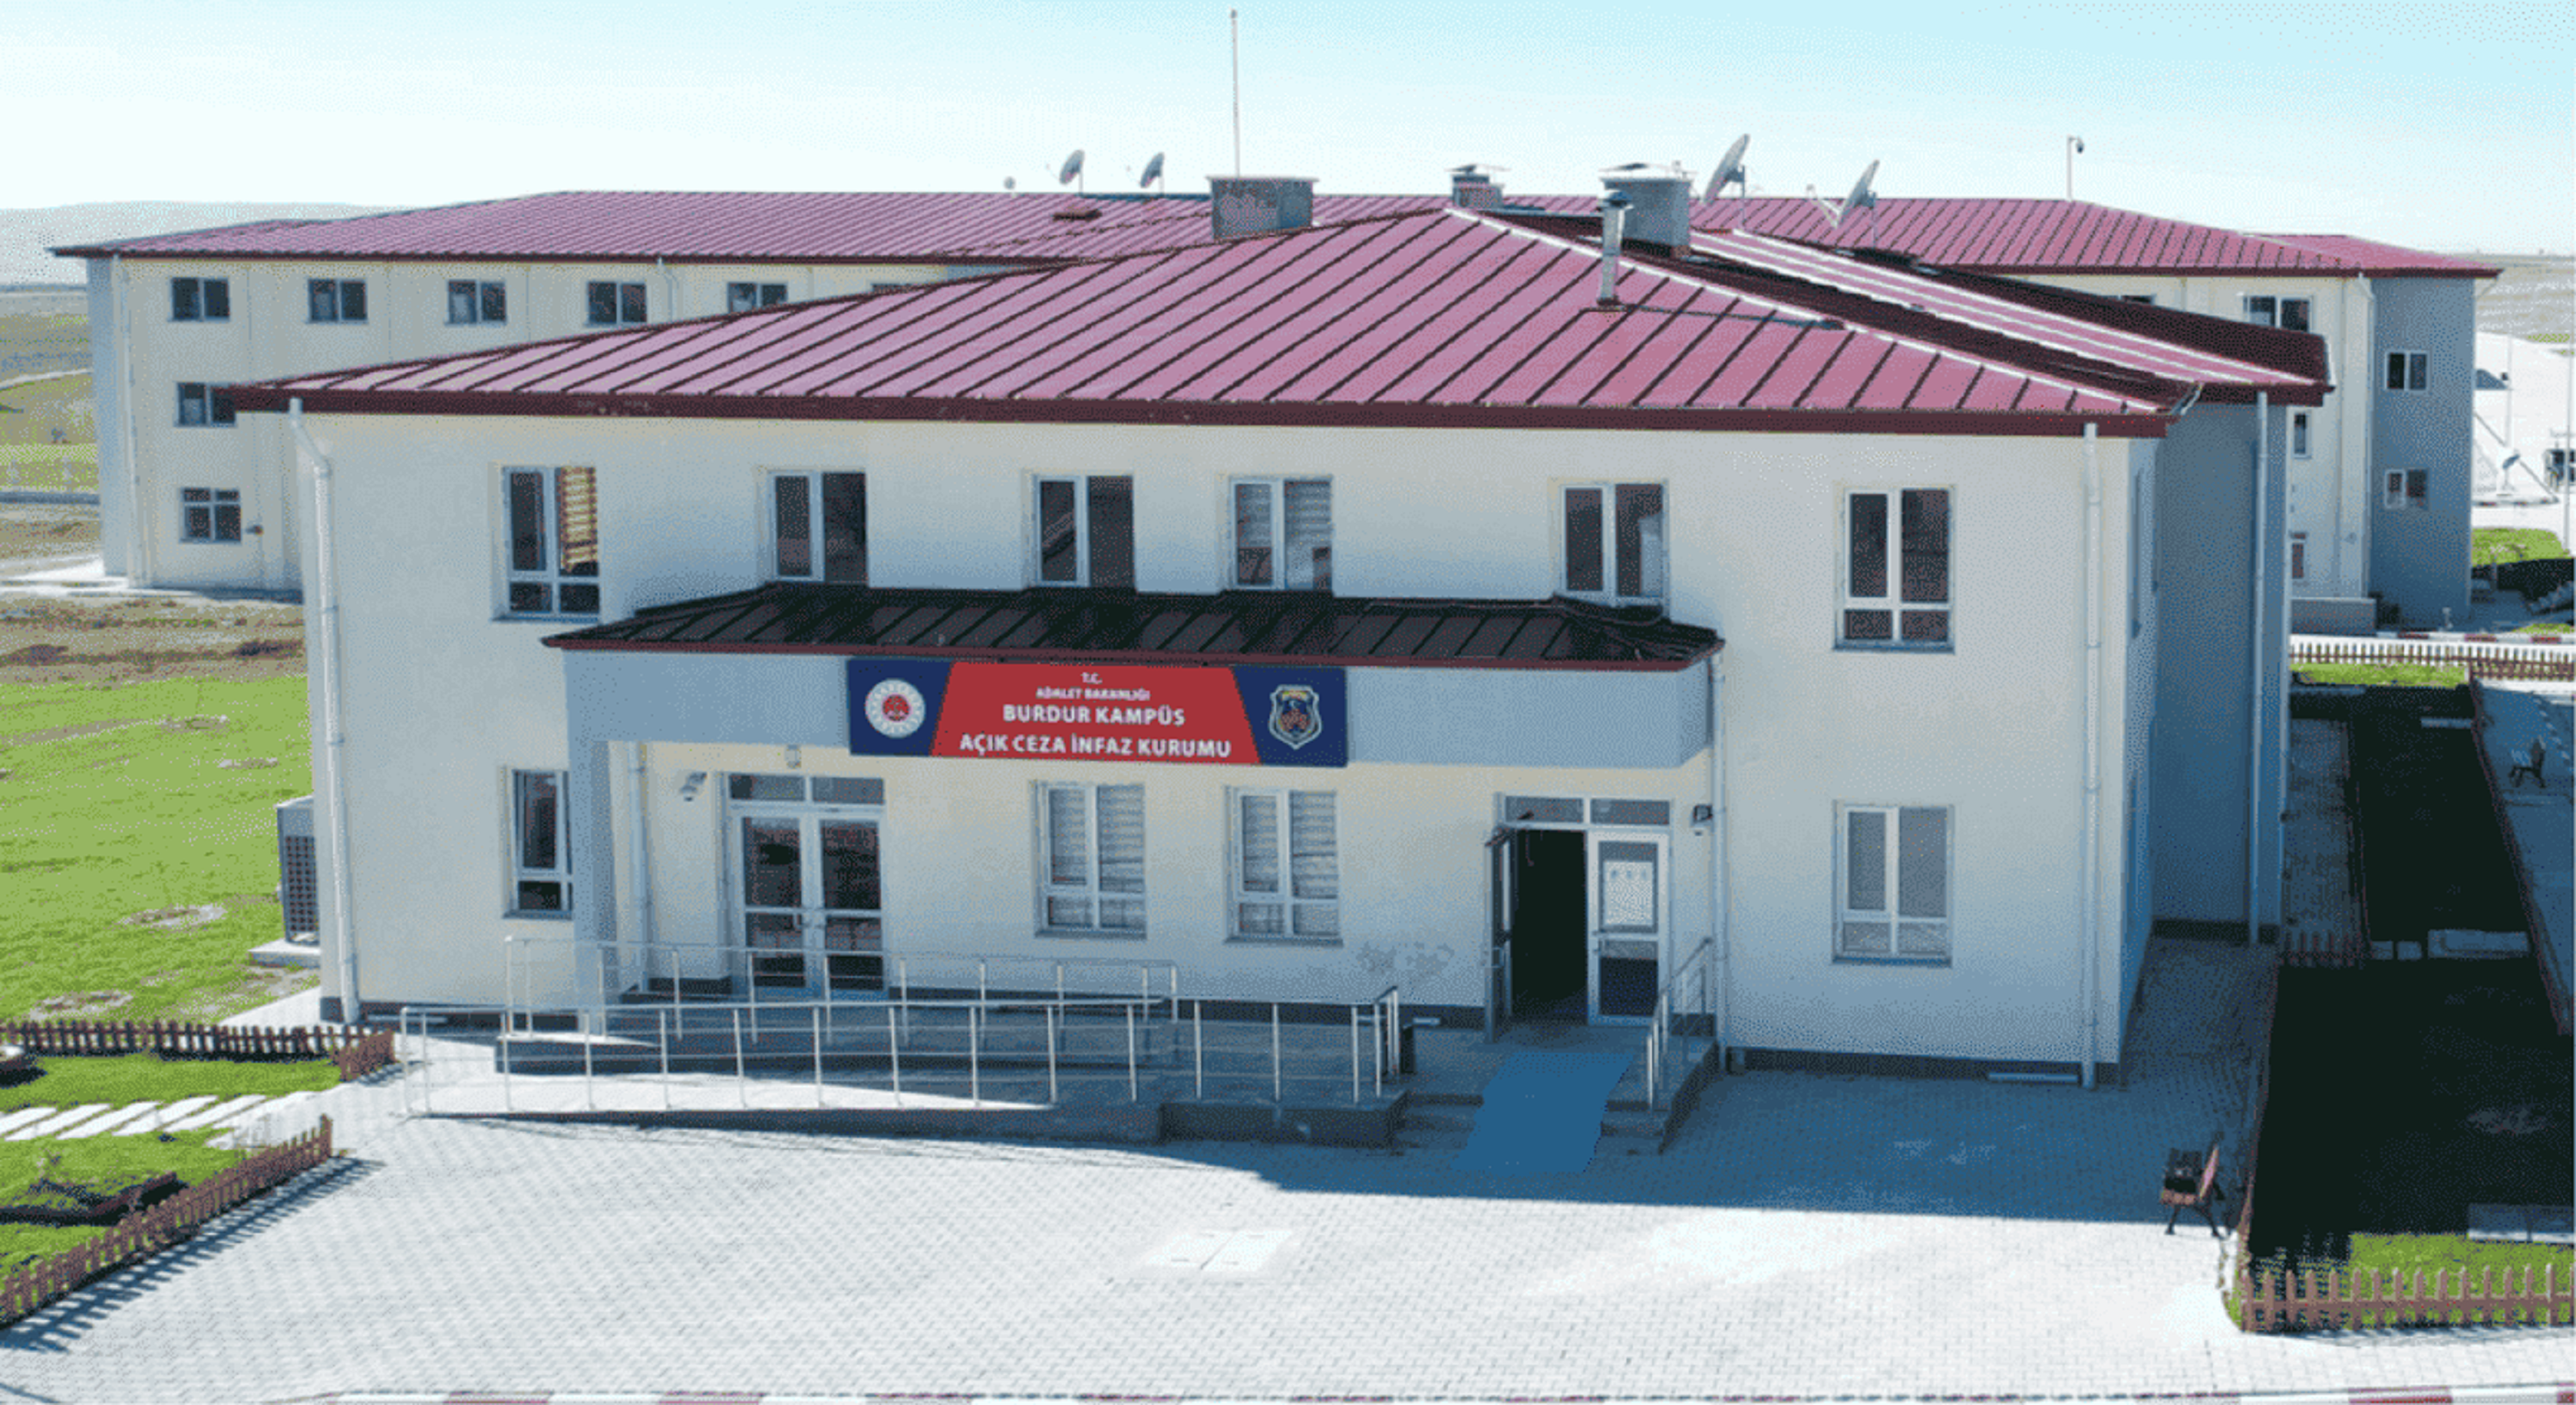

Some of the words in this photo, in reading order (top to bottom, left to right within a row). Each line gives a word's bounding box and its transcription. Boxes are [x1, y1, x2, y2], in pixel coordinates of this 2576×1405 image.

[1003, 704, 1091, 724] BURDUR
[1095, 704, 1186, 726] KAMPÜS
[960, 733, 1008, 756] AÇIK
[1012, 735, 1066, 754] CEZA
[1071, 733, 1133, 756] İNFAZ
[1137, 738, 1231, 758] KURUMU
